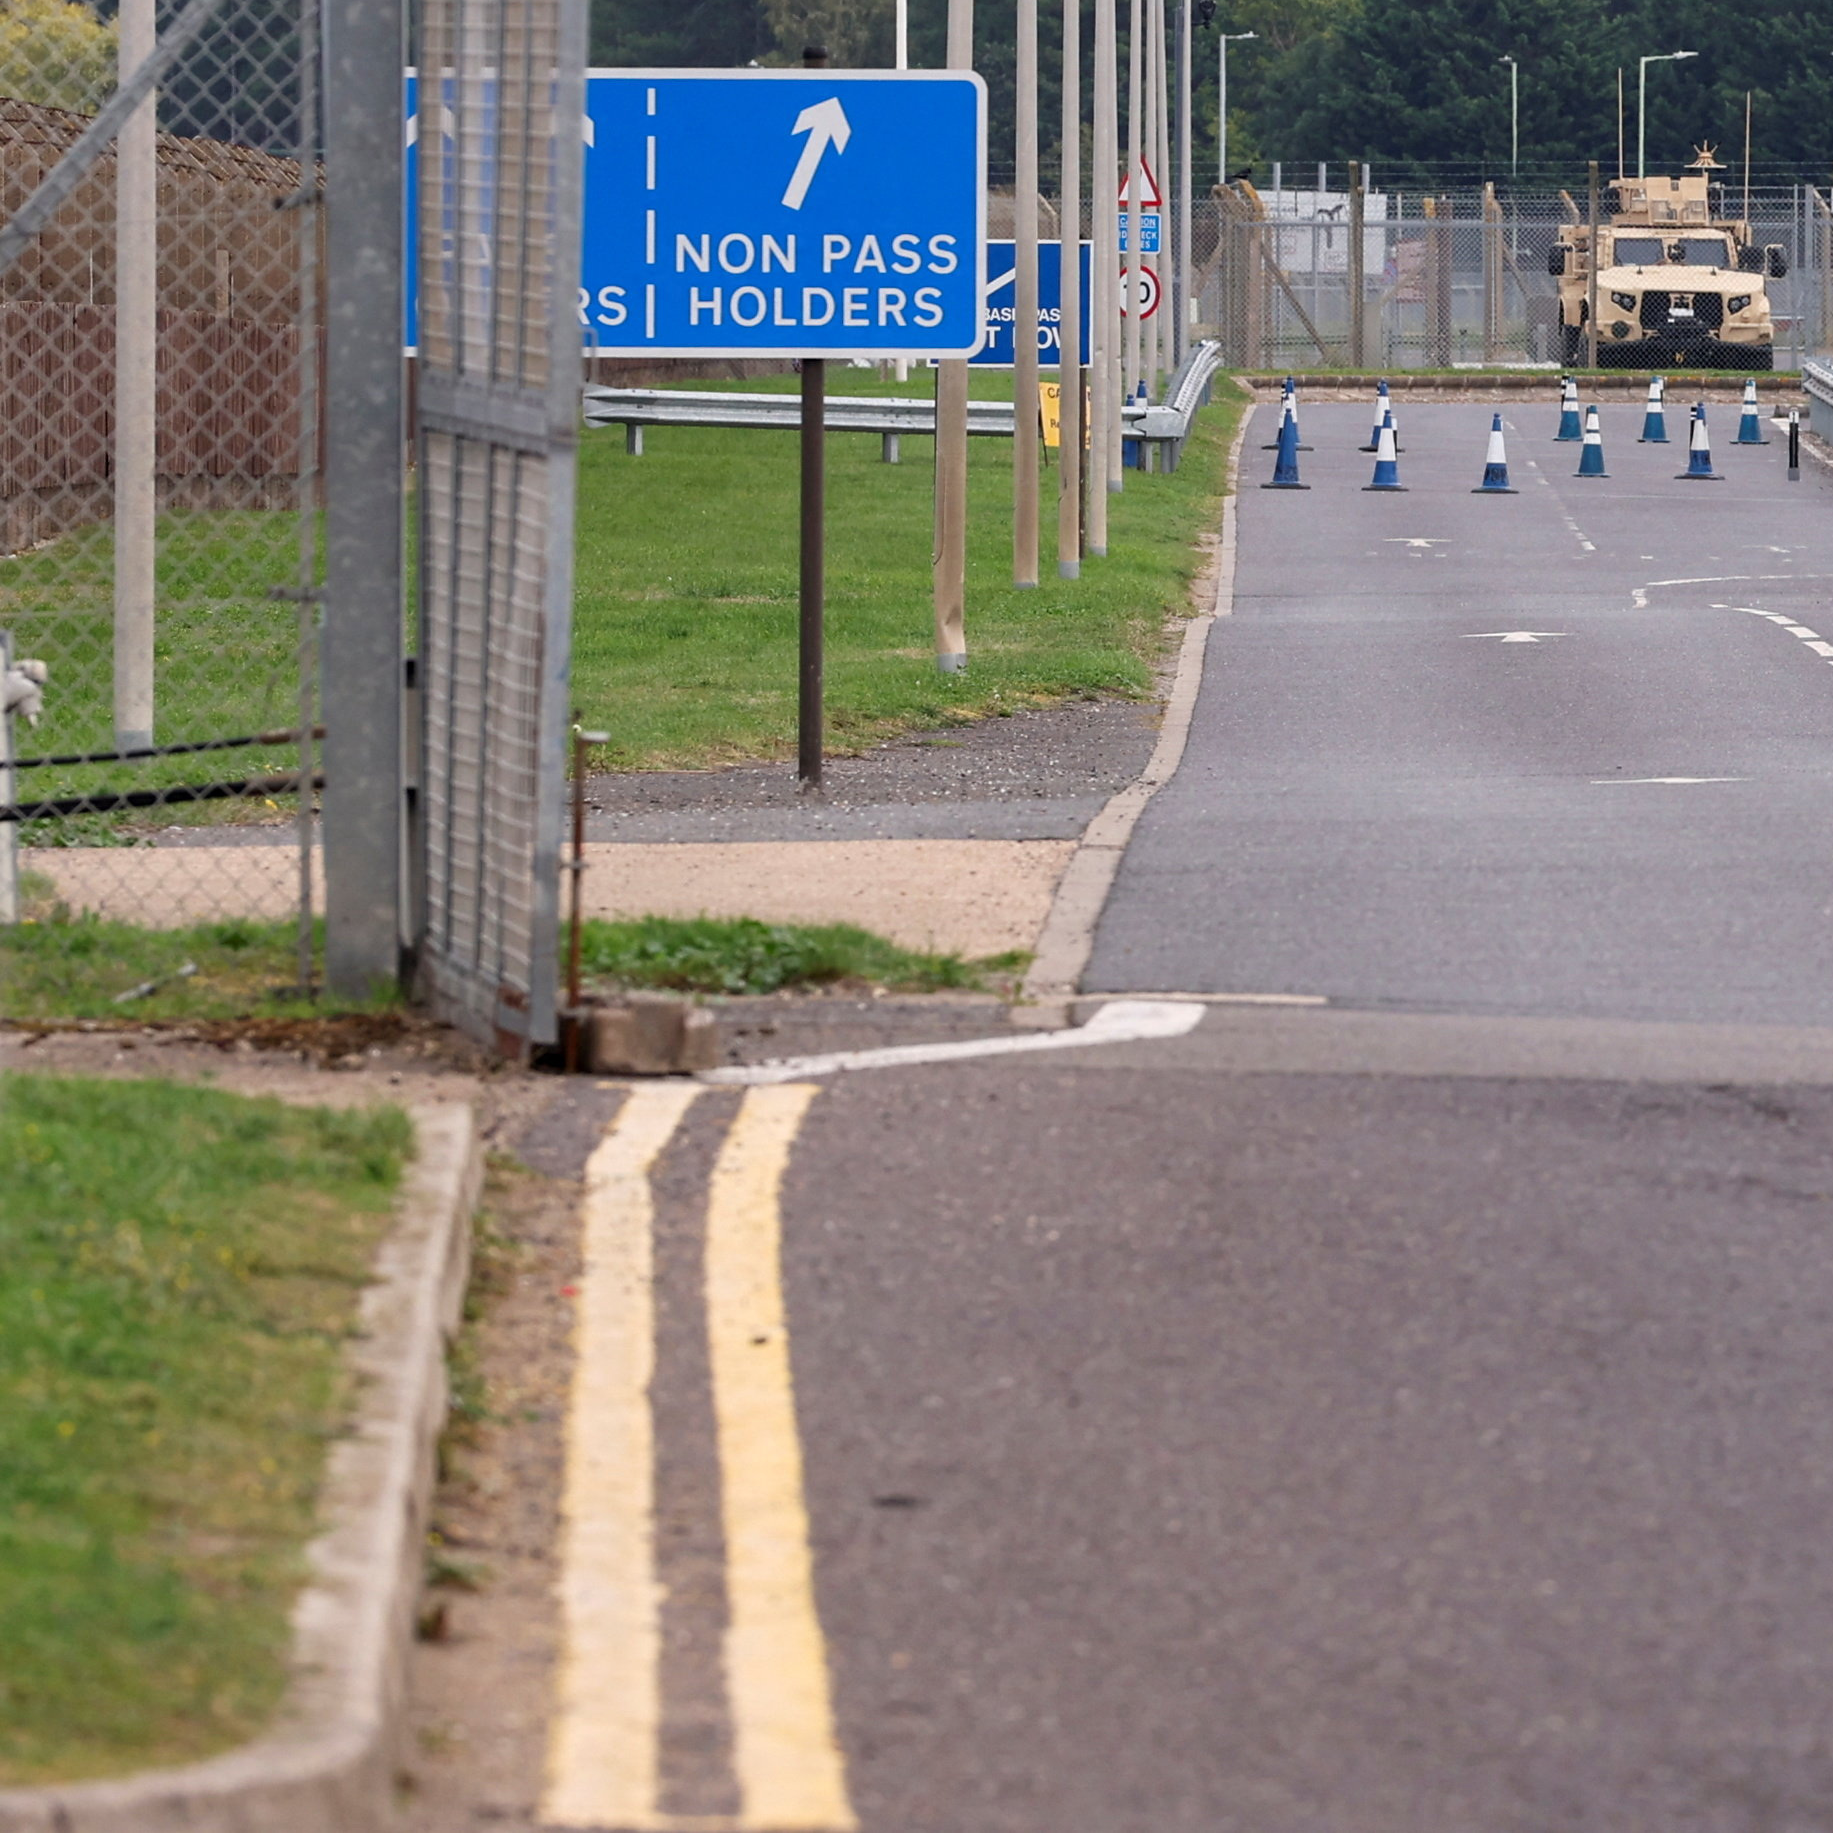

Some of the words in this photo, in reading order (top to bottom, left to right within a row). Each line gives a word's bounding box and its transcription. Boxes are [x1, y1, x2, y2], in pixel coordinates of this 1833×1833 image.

[675, 233, 797, 274] NON
[822, 233, 958, 274] PASS
[689, 286, 943, 327] HOLDERS
